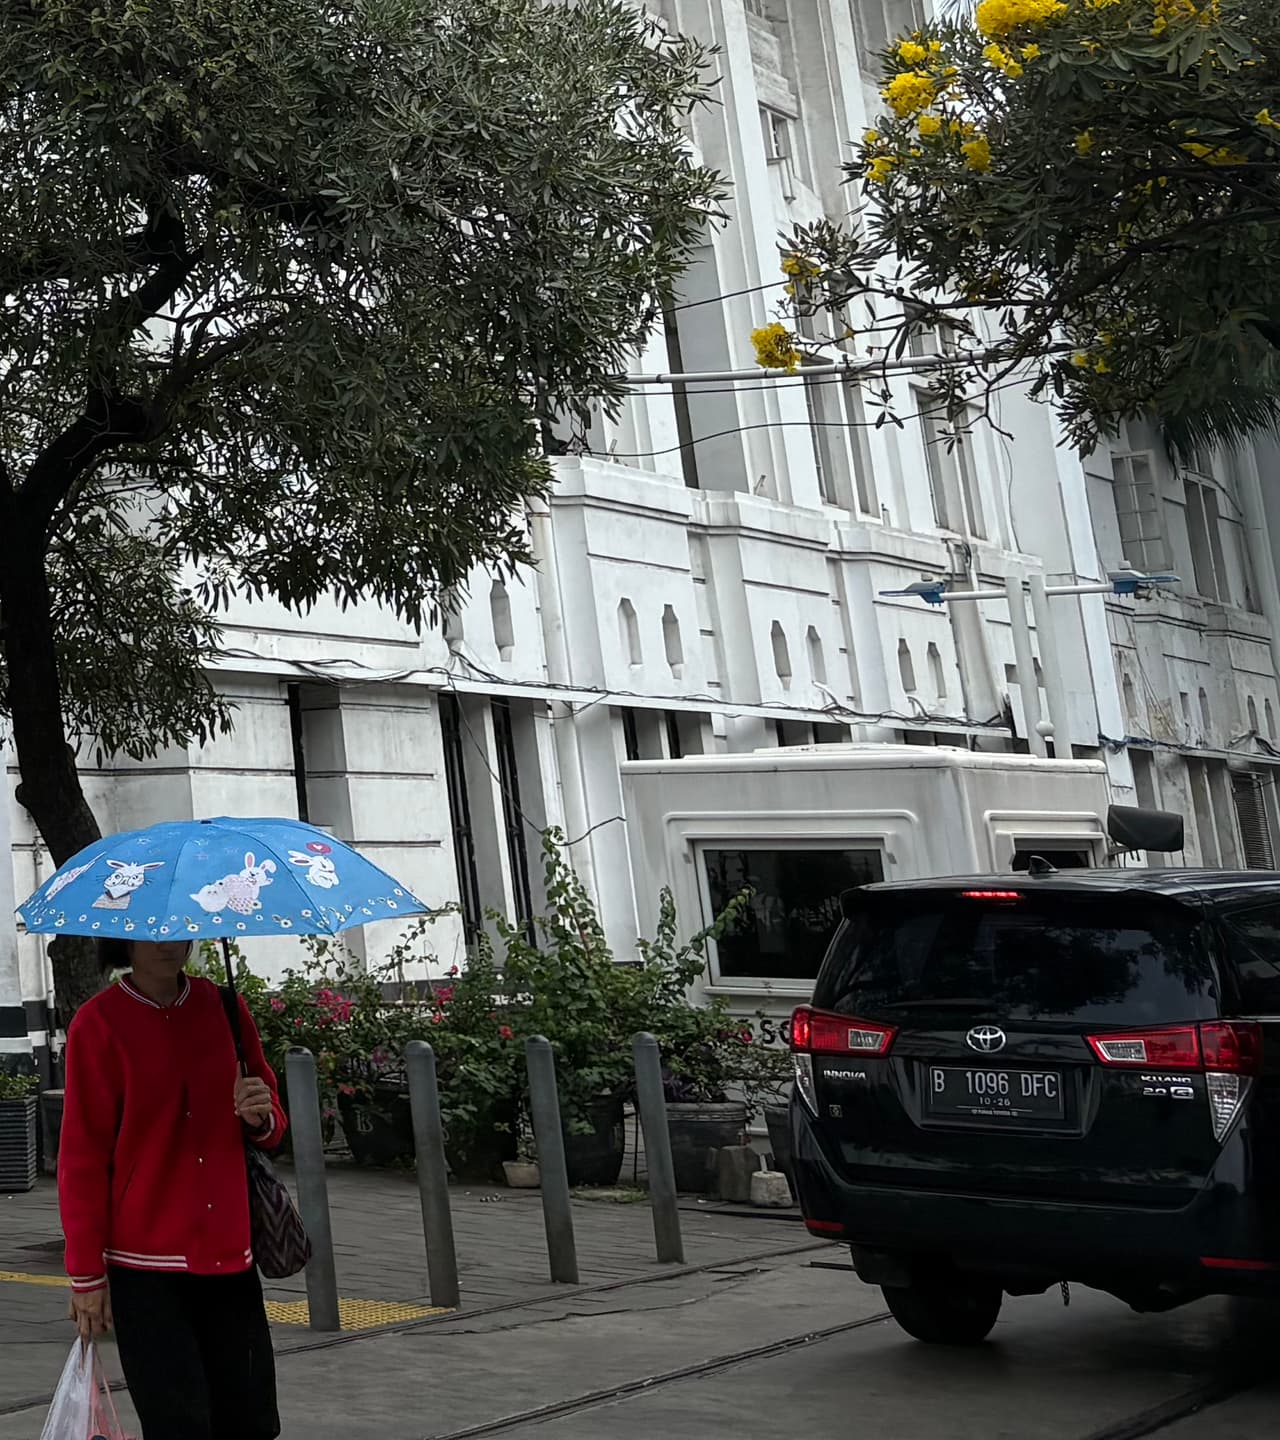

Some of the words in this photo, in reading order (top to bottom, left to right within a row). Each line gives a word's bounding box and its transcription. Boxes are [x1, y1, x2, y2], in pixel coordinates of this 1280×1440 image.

[933, 1069, 945, 1093] B
[965, 1071, 1009, 1095] 1096
[1020, 1073, 1057, 1098] DFC
